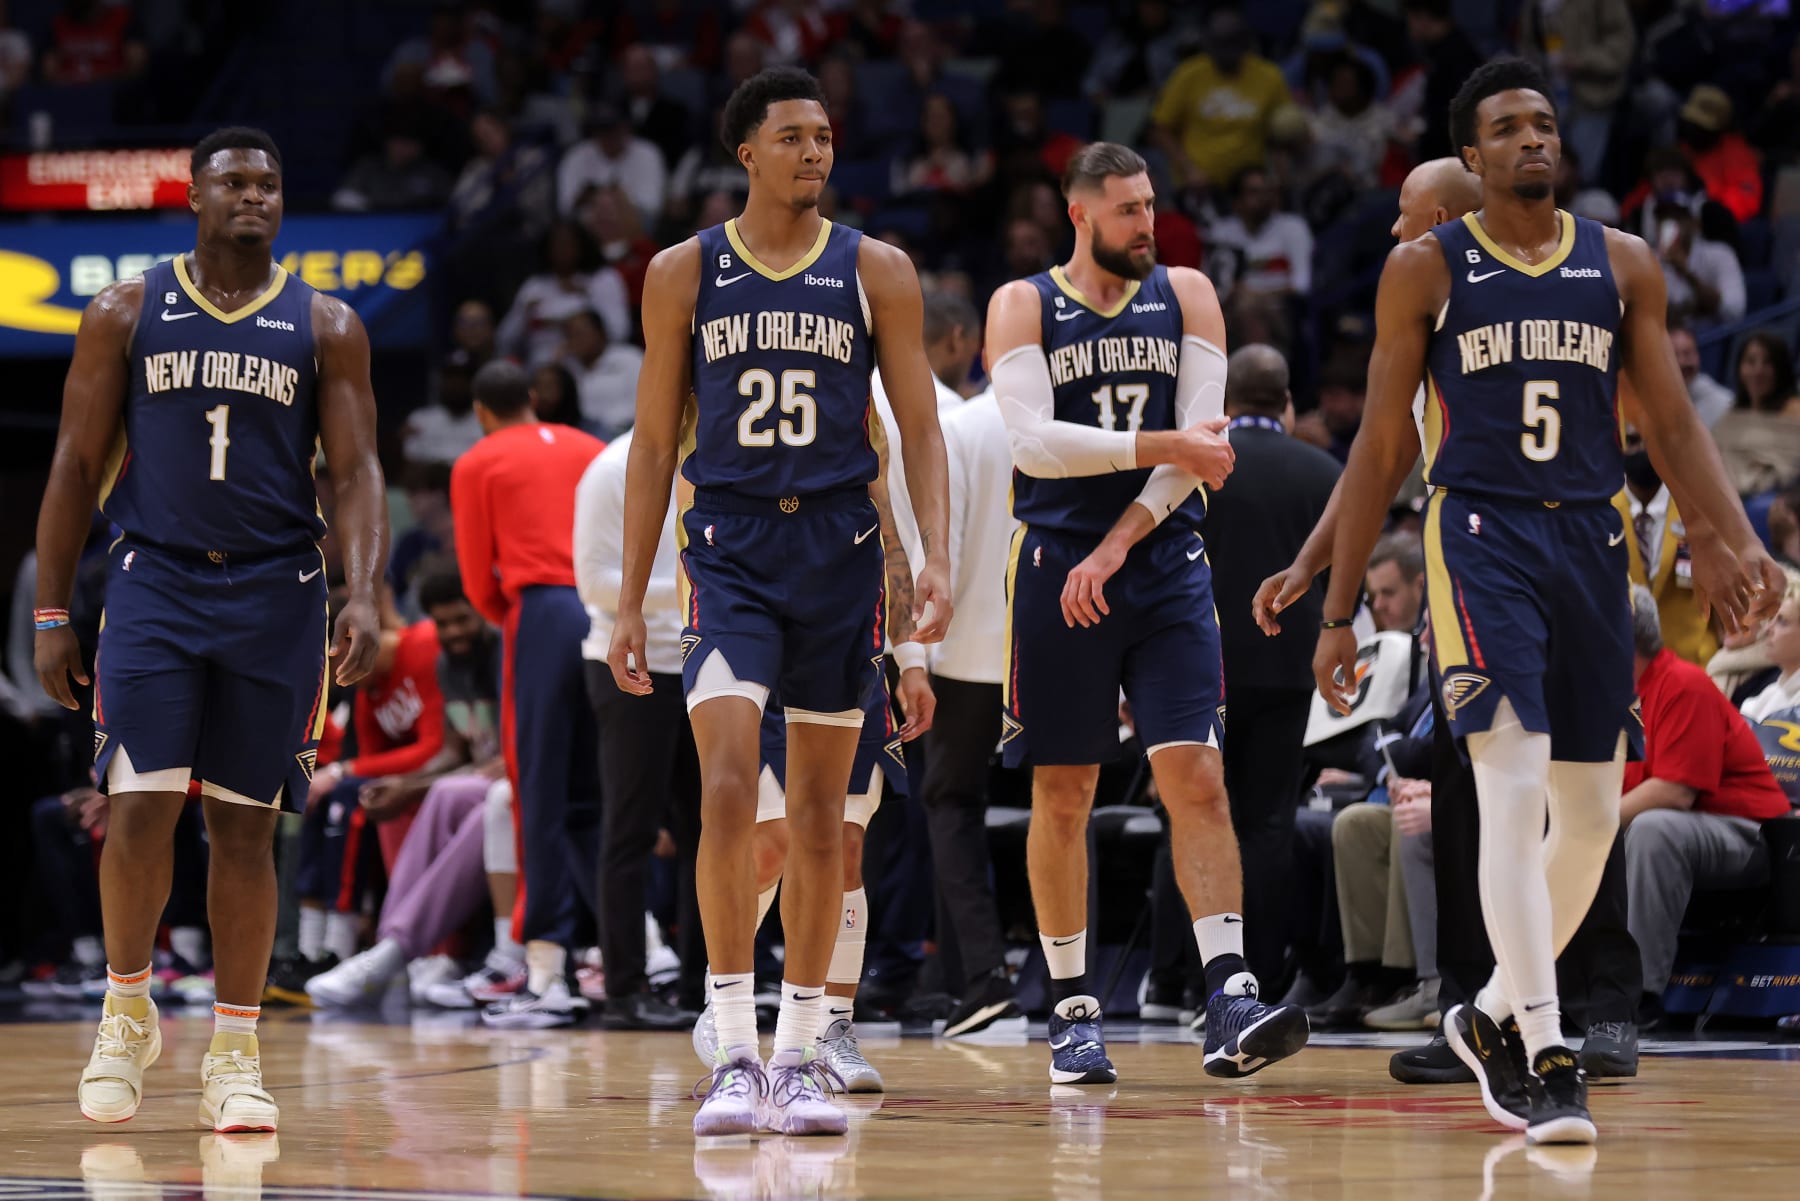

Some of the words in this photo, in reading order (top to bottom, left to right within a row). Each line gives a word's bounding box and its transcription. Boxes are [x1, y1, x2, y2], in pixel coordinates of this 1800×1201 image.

[28, 149, 193, 184] EMERGENC
[717, 254, 731, 268] 6
[1466, 249, 1481, 264] 6
[1560, 266, 1602, 279] ibotta
[165, 291, 177, 305] 6
[804, 273, 844, 288] ibotta
[256, 316, 295, 331] ibotta
[1131, 302, 1167, 314] ibotta
[701, 312, 751, 364] NEW
[756, 311, 854, 364] ORLEANS
[1456, 321, 1513, 375] NEW
[1519, 319, 1613, 373] ORLEANS
[144, 349, 198, 394] NEW
[201, 350, 299, 407] ORLEANS
[1049, 340, 1093, 388] NEW
[1097, 336, 1178, 378] ORLEANS
[737, 368, 817, 447] 25
[1091, 383, 1150, 432] 17
[1520, 379, 1561, 462] 5
[205, 404, 230, 481] 1
